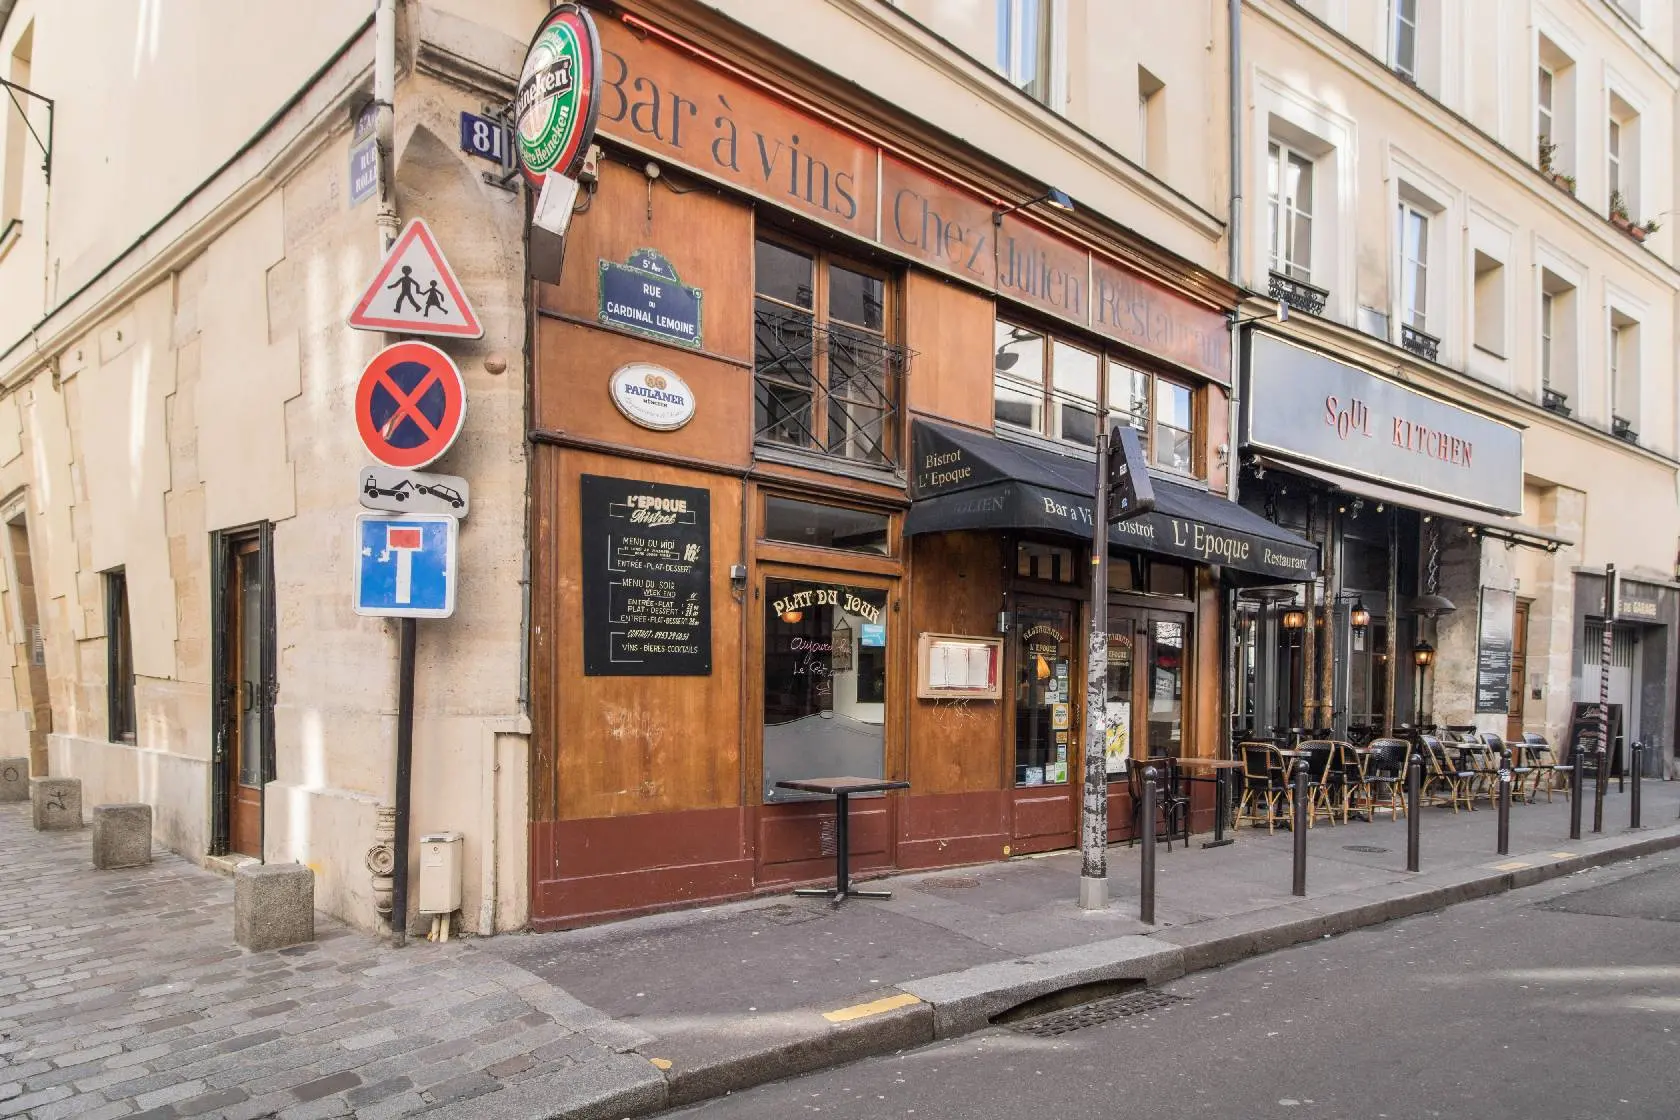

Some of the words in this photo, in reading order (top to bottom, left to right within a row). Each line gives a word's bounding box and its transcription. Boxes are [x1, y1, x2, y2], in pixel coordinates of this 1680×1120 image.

[473, 120, 501, 158] 81
[536, 105, 569, 165] Heineken
[600, 50, 697, 148] Bar
[711, 94, 740, 172] à
[753, 131, 857, 220] vins
[894, 188, 986, 277] Chez
[1001, 237, 1080, 314] Julien
[643, 283, 662, 298] RUE
[606, 301, 653, 324] CARDINAL
[656, 314, 694, 335] LEMOINE
[624, 384, 685, 406] PAULANER
[1325, 395, 1372, 441] SOUL
[1392, 416, 1473, 468] KITCHEN
[926, 449, 961, 469] Bistrot
[627, 495, 687, 513] L'EPOQUE
[1042, 496, 1067, 517] Bar
[1118, 520, 1155, 539] Bistrot
[622, 536, 645, 546] MENU
[617, 557, 643, 569] ENTRÉE
[646, 562, 663, 571] PLAT
[665, 564, 692, 574] DESSERT
[1264, 548, 1308, 571] Restaurant
[622, 578, 644, 588] MENU
[645, 579, 655, 588] DU
[627, 597, 654, 607] ENTRÉE
[627, 605, 645, 613] PLAT
[772, 590, 812, 617] PLAT
[816, 589, 838, 605] DU
[843, 593, 880, 624] JOUR
